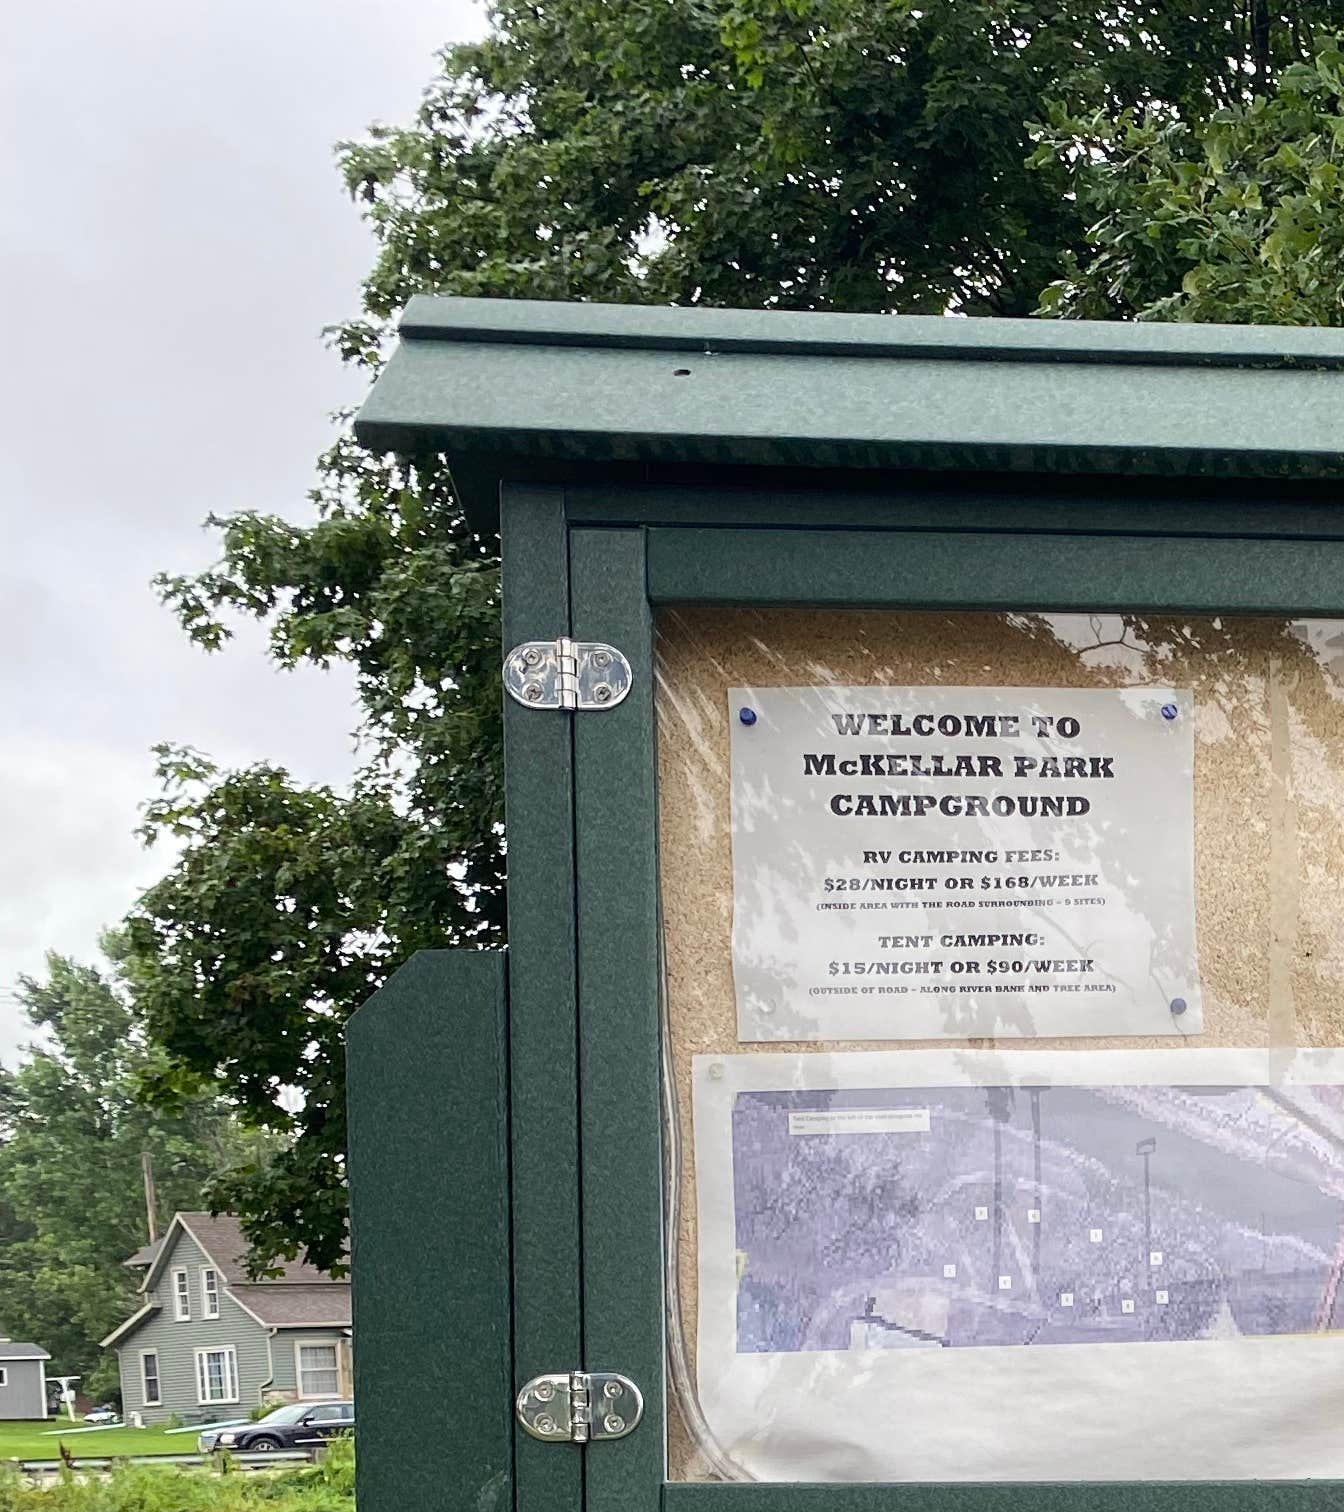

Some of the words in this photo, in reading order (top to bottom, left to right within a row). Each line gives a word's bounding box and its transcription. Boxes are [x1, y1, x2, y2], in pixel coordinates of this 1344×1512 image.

[832, 714, 1020, 738] WELCOME
[1031, 715, 1081, 738] TO
[804, 754, 1004, 778] McKELLAR
[1013, 755, 1114, 778] PARK
[830, 795, 1090, 817] CAMPGROUND
[862, 850, 893, 864] RV
[899, 850, 998, 864] CAMPING
[1004, 850, 1060, 862] FEES:
[824, 876, 938, 892] $28/NIGHT
[944, 877, 974, 890] OR
[980, 874, 1099, 891] $168/WEEK
[816, 902, 856, 911] (INSIDE
[978, 900, 1053, 908] SURROUNDING
[1074, 898, 1105, 906] SITES)
[878, 936, 933, 948] TENT
[940, 934, 1045, 948] CAMPING:
[829, 961, 943, 976] $15/NIGHT
[950, 961, 980, 974] OR
[987, 960, 1094, 975] $90/WEEK
[809, 986, 857, 996] (OUTSIDE
[1086, 985, 1116, 993] AREA)
